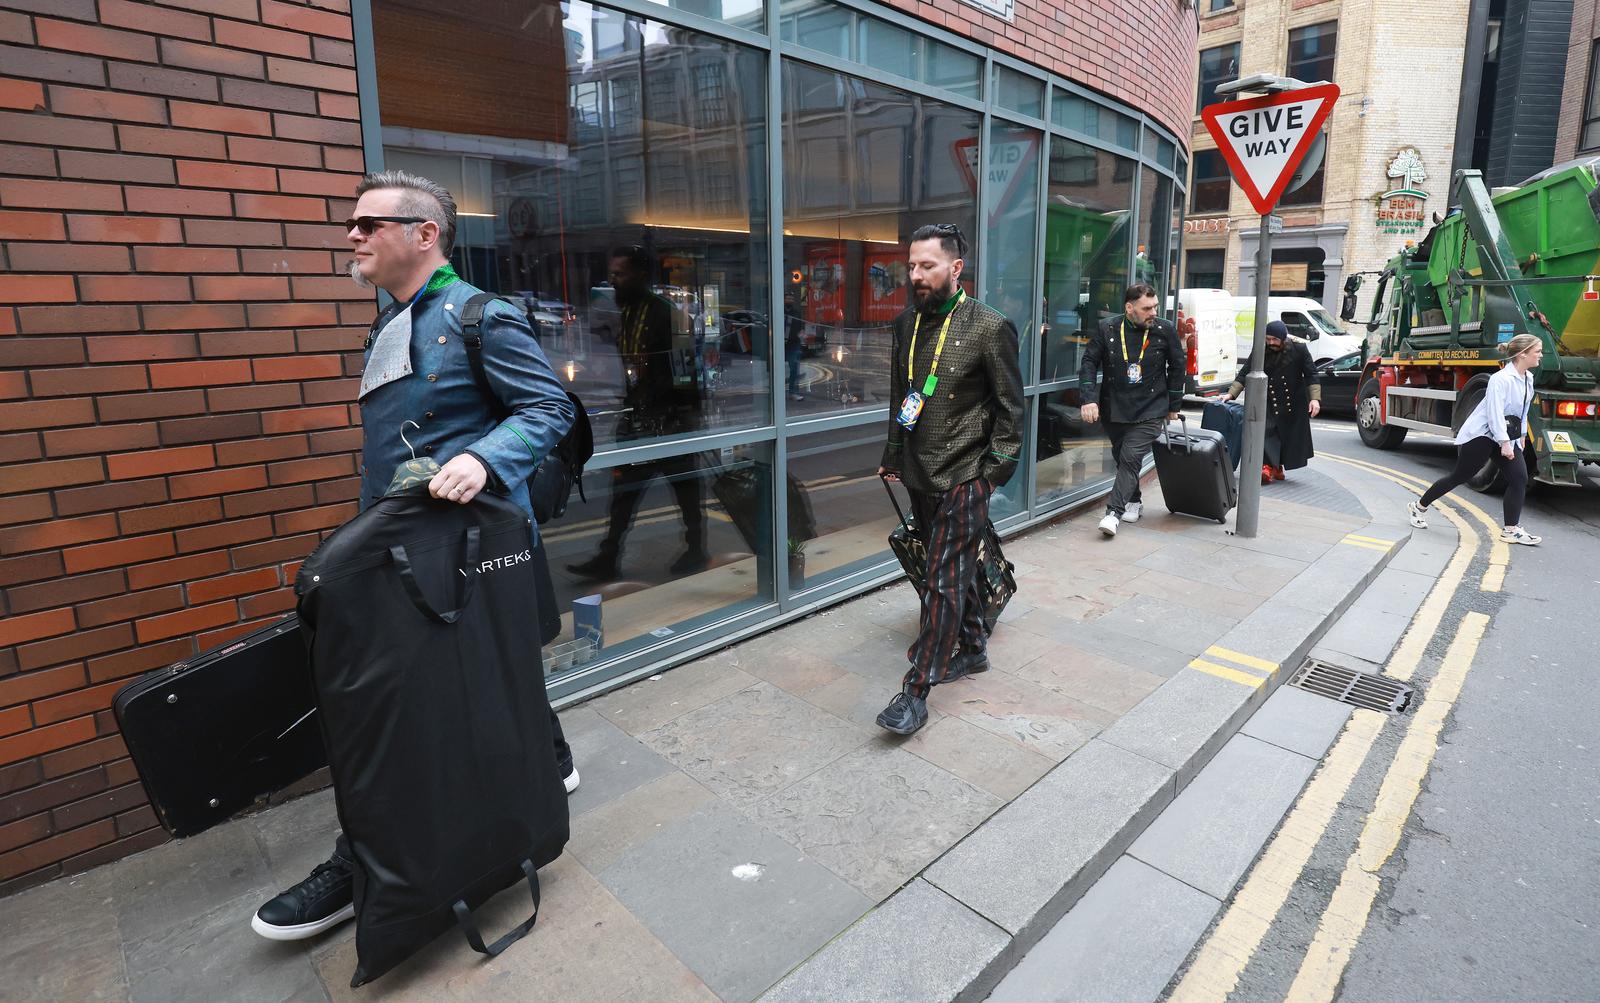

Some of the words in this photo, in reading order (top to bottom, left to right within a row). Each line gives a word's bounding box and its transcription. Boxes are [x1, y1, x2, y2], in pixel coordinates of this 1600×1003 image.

[1229, 105, 1303, 138] GIVE
[1245, 138, 1291, 158] WAY
[1379, 209, 1425, 220] BRASIL
[1418, 351, 1443, 359] COMMITTED
[1451, 350, 1479, 358] RECYCLING
